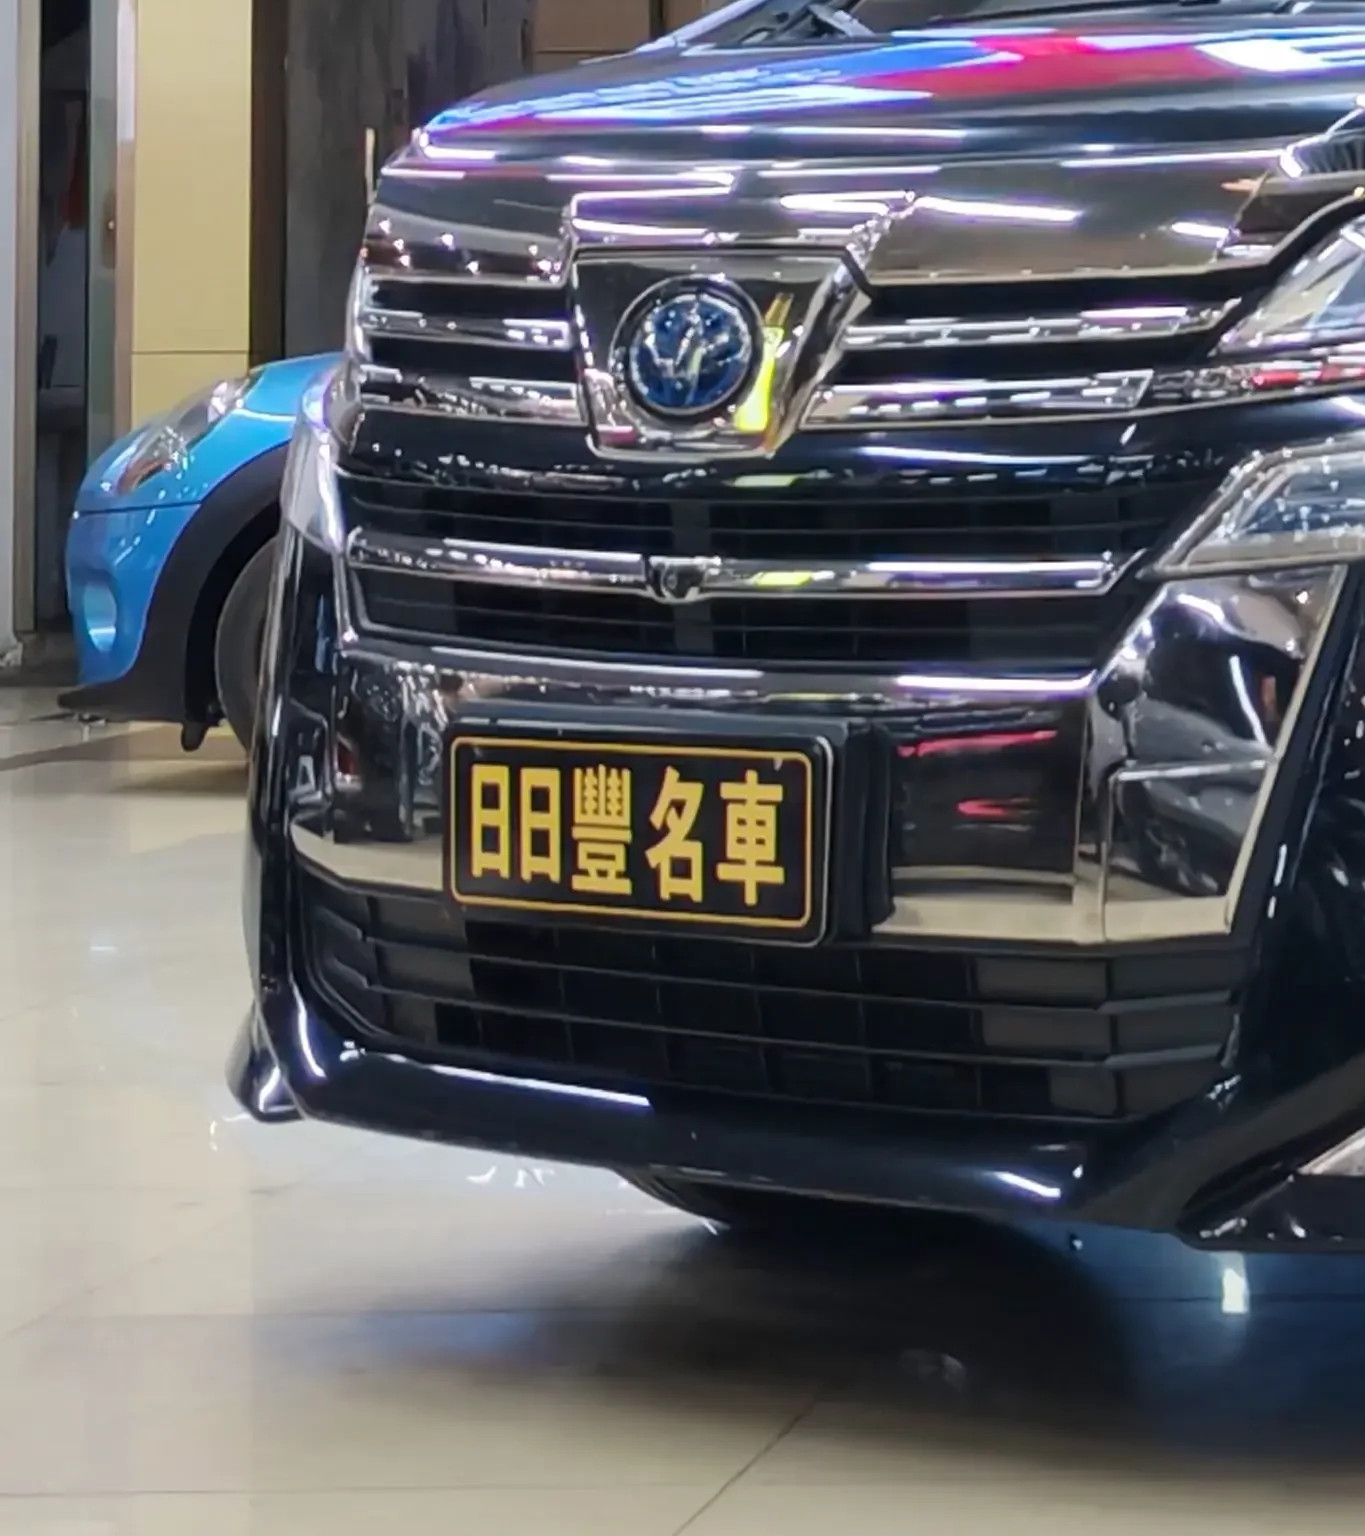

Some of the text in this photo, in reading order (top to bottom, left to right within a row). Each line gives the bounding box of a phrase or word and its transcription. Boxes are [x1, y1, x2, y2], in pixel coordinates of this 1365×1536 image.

[470, 764, 786, 906] 日日豐名車
